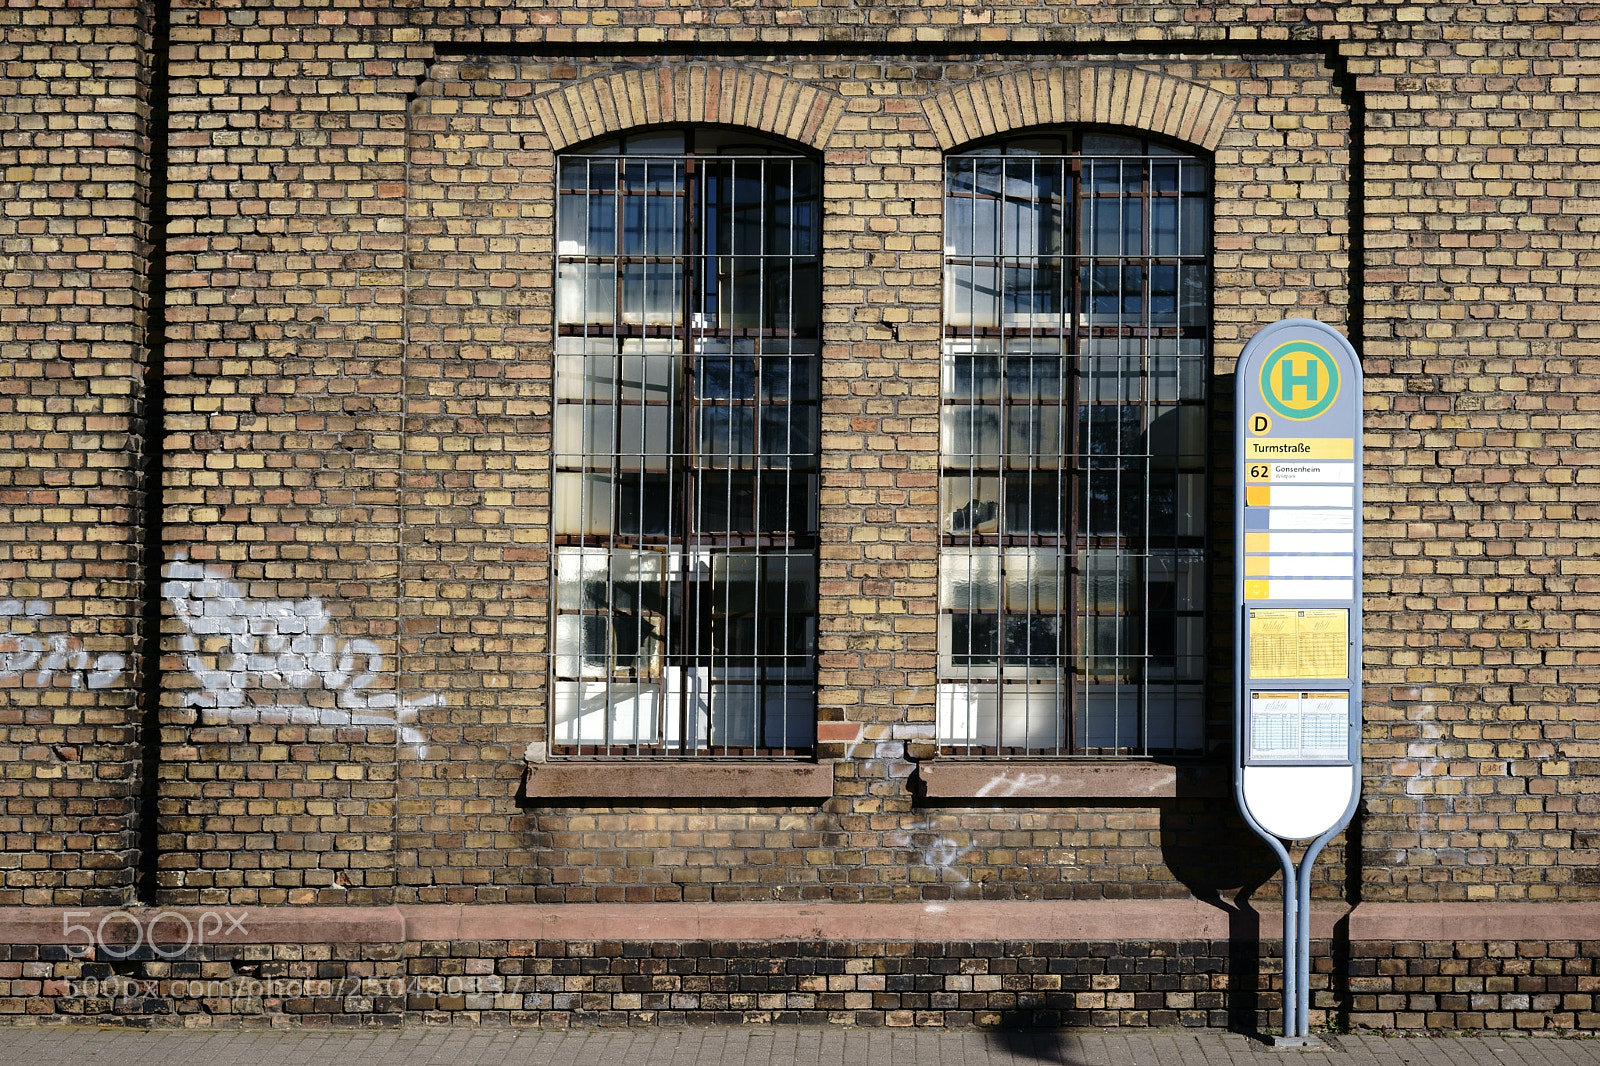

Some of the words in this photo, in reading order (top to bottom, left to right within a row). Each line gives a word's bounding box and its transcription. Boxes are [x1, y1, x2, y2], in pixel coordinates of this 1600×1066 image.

[1281, 360, 1318, 401] H
[1254, 416, 1268, 432] D
[1252, 443, 1311, 453] Turmstraße
[1250, 465, 1269, 478] 62
[1275, 465, 1321, 473] Gonsenheim
